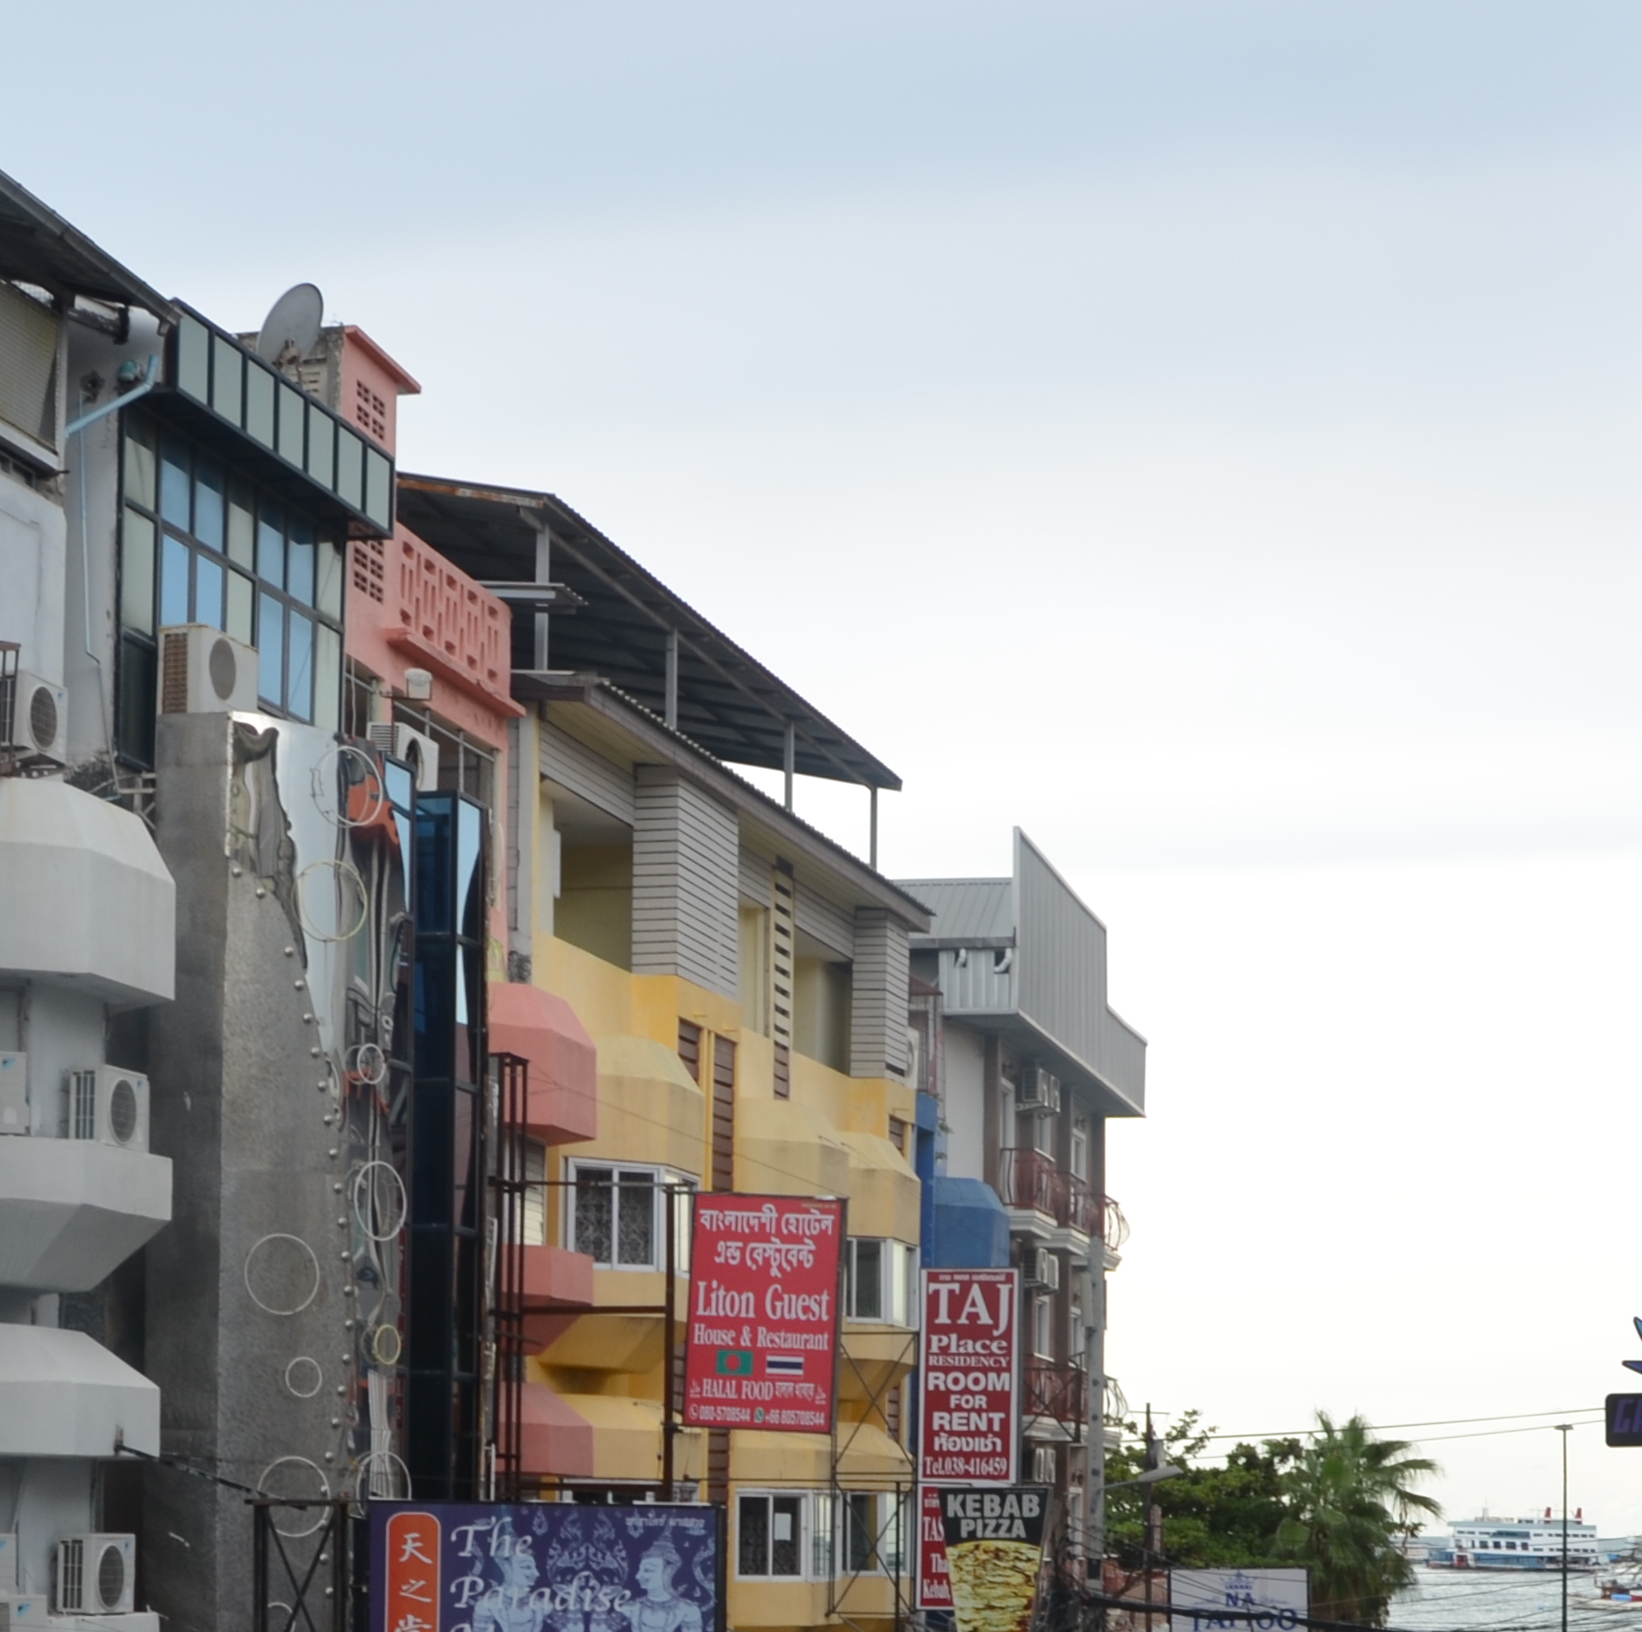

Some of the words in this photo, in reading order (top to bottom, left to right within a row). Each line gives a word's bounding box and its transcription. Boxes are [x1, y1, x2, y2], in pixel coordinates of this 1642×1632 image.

[781, 1208, 835, 1235] হোটেল
[696, 1280, 756, 1318] Liton
[765, 1284, 830, 1321] Guest
[928, 1282, 1013, 1337] TAJ
[693, 1323, 736, 1346] House
[740, 1325, 752, 1347] &
[757, 1326, 829, 1350] Restaurant
[929, 1333, 1008, 1355] Place
[928, 1355, 1010, 1368] RESIDENCY
[702, 1378, 738, 1399] HALAL
[741, 1381, 774, 1400] FOOD
[927, 1371, 1010, 1392] ROOM
[949, 1394, 987, 1409] FOR
[932, 1412, 1005, 1432] RENT
[934, 1432, 1002, 1453] ห้องเช่า
[947, 1494, 1040, 1518] KEBAB
[450, 1516, 533, 1557] The
[923, 1517, 945, 1541] TAS
[960, 1519, 1027, 1539] PIZZA
[450, 1571, 632, 1612] Paradise
